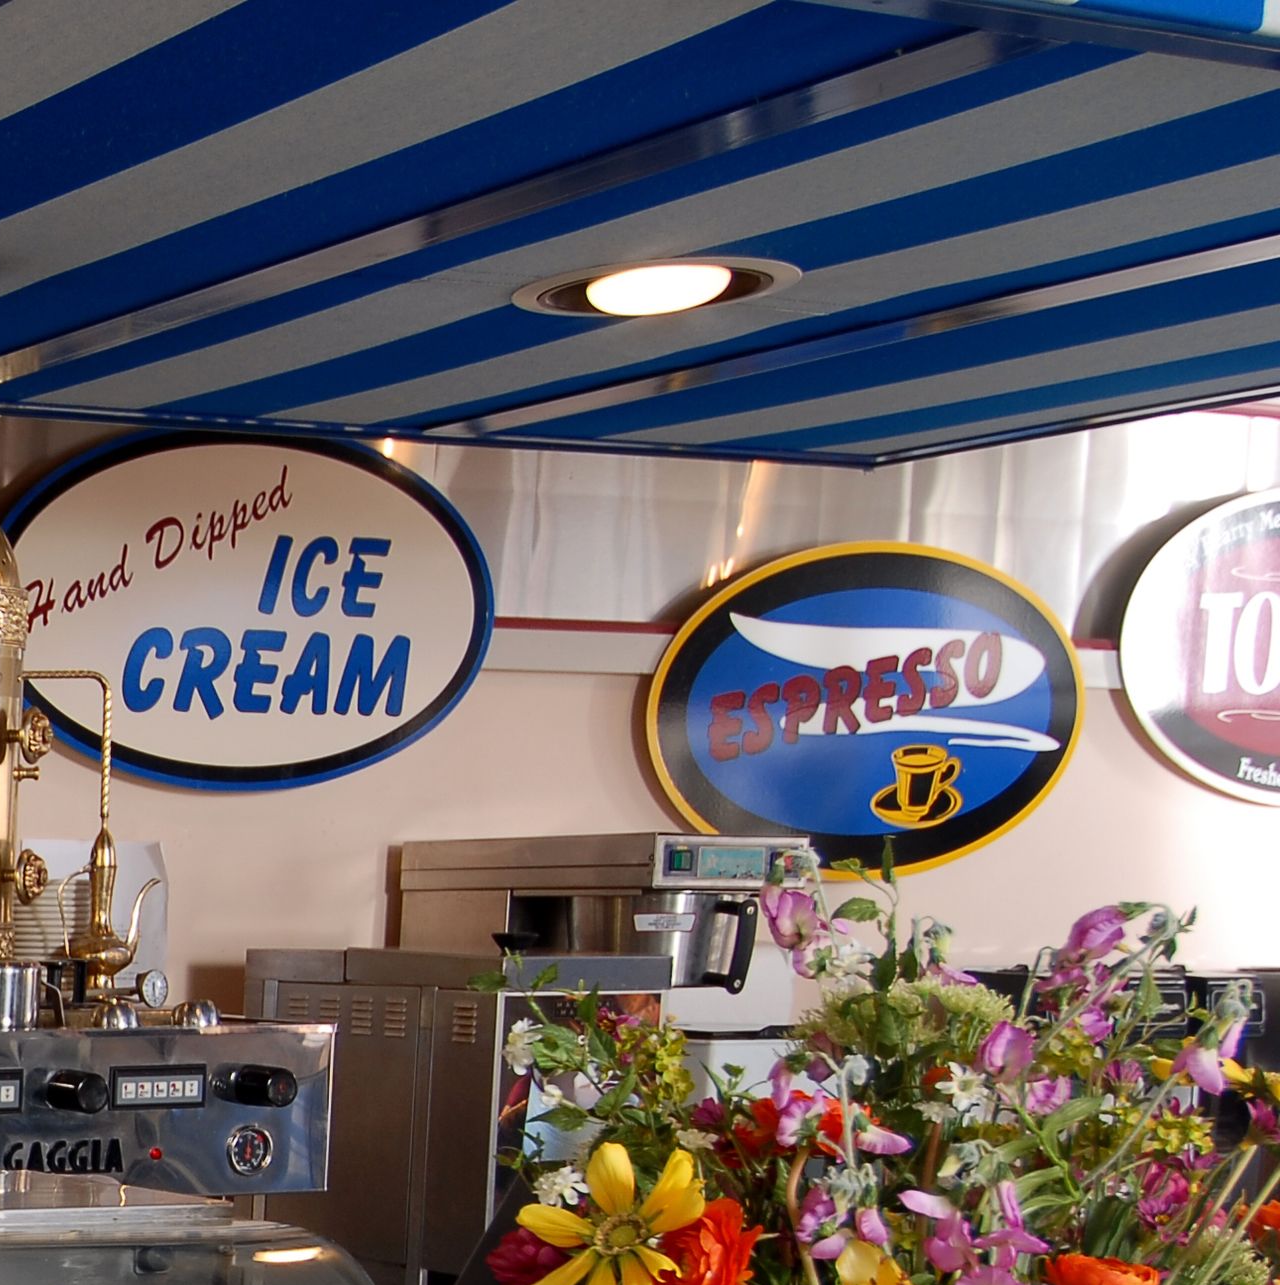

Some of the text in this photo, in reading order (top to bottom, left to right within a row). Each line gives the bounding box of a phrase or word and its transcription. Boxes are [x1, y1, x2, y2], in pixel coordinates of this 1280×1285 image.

[26, 464, 293, 633] Hand Dipped
[257, 533, 393, 619] ICE
[121, 626, 411, 720] CREAM
[706, 631, 1003, 763] ESPRESSO
[2, 1138, 124, 1173] GAGGIA
